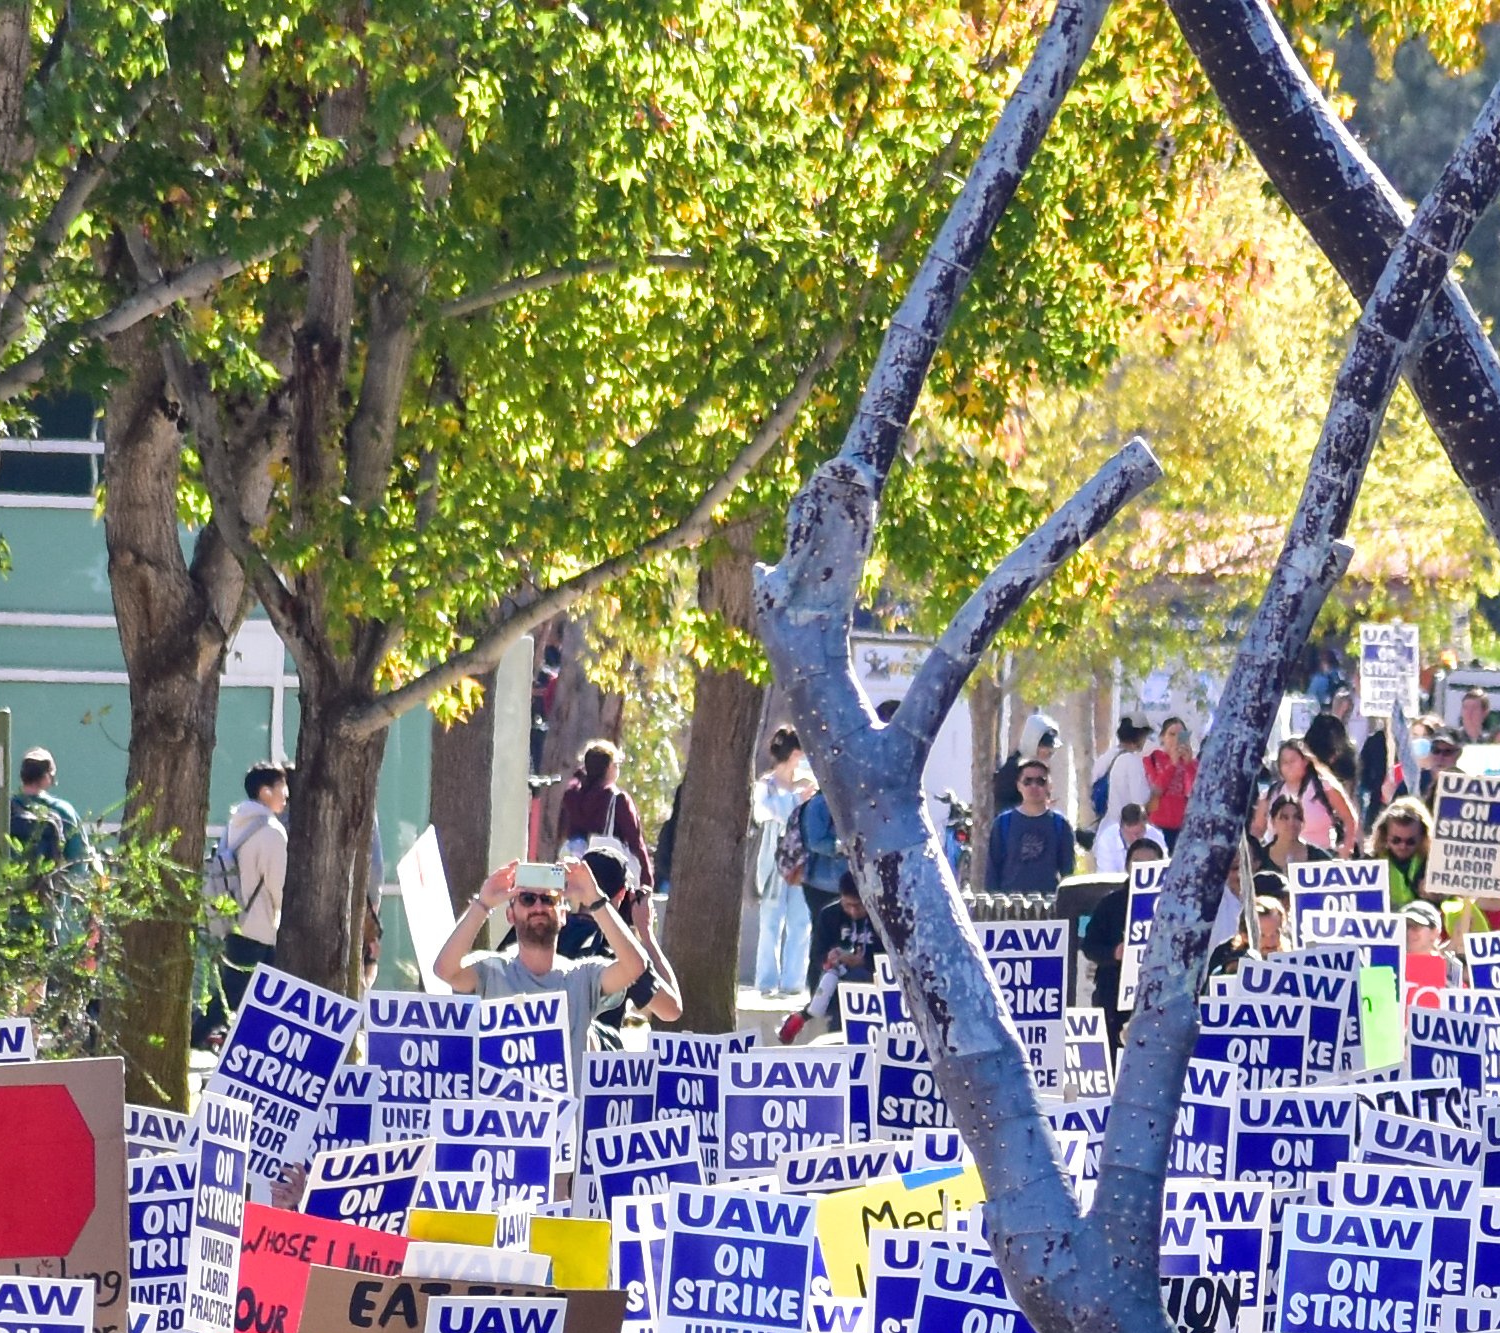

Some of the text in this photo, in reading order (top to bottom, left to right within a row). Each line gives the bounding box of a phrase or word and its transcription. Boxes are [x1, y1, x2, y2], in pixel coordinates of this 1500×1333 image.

[1459, 800, 1490, 821] ON
[1442, 842, 1497, 861] UNFAIR
[1443, 858, 1493, 875] LABOR
[241, 1225, 320, 1264] WHOSE
[1295, 1211, 1423, 1250] UAW
[1326, 1257, 1379, 1293] ON
[1285, 1291, 1414, 1333] STRIKE
